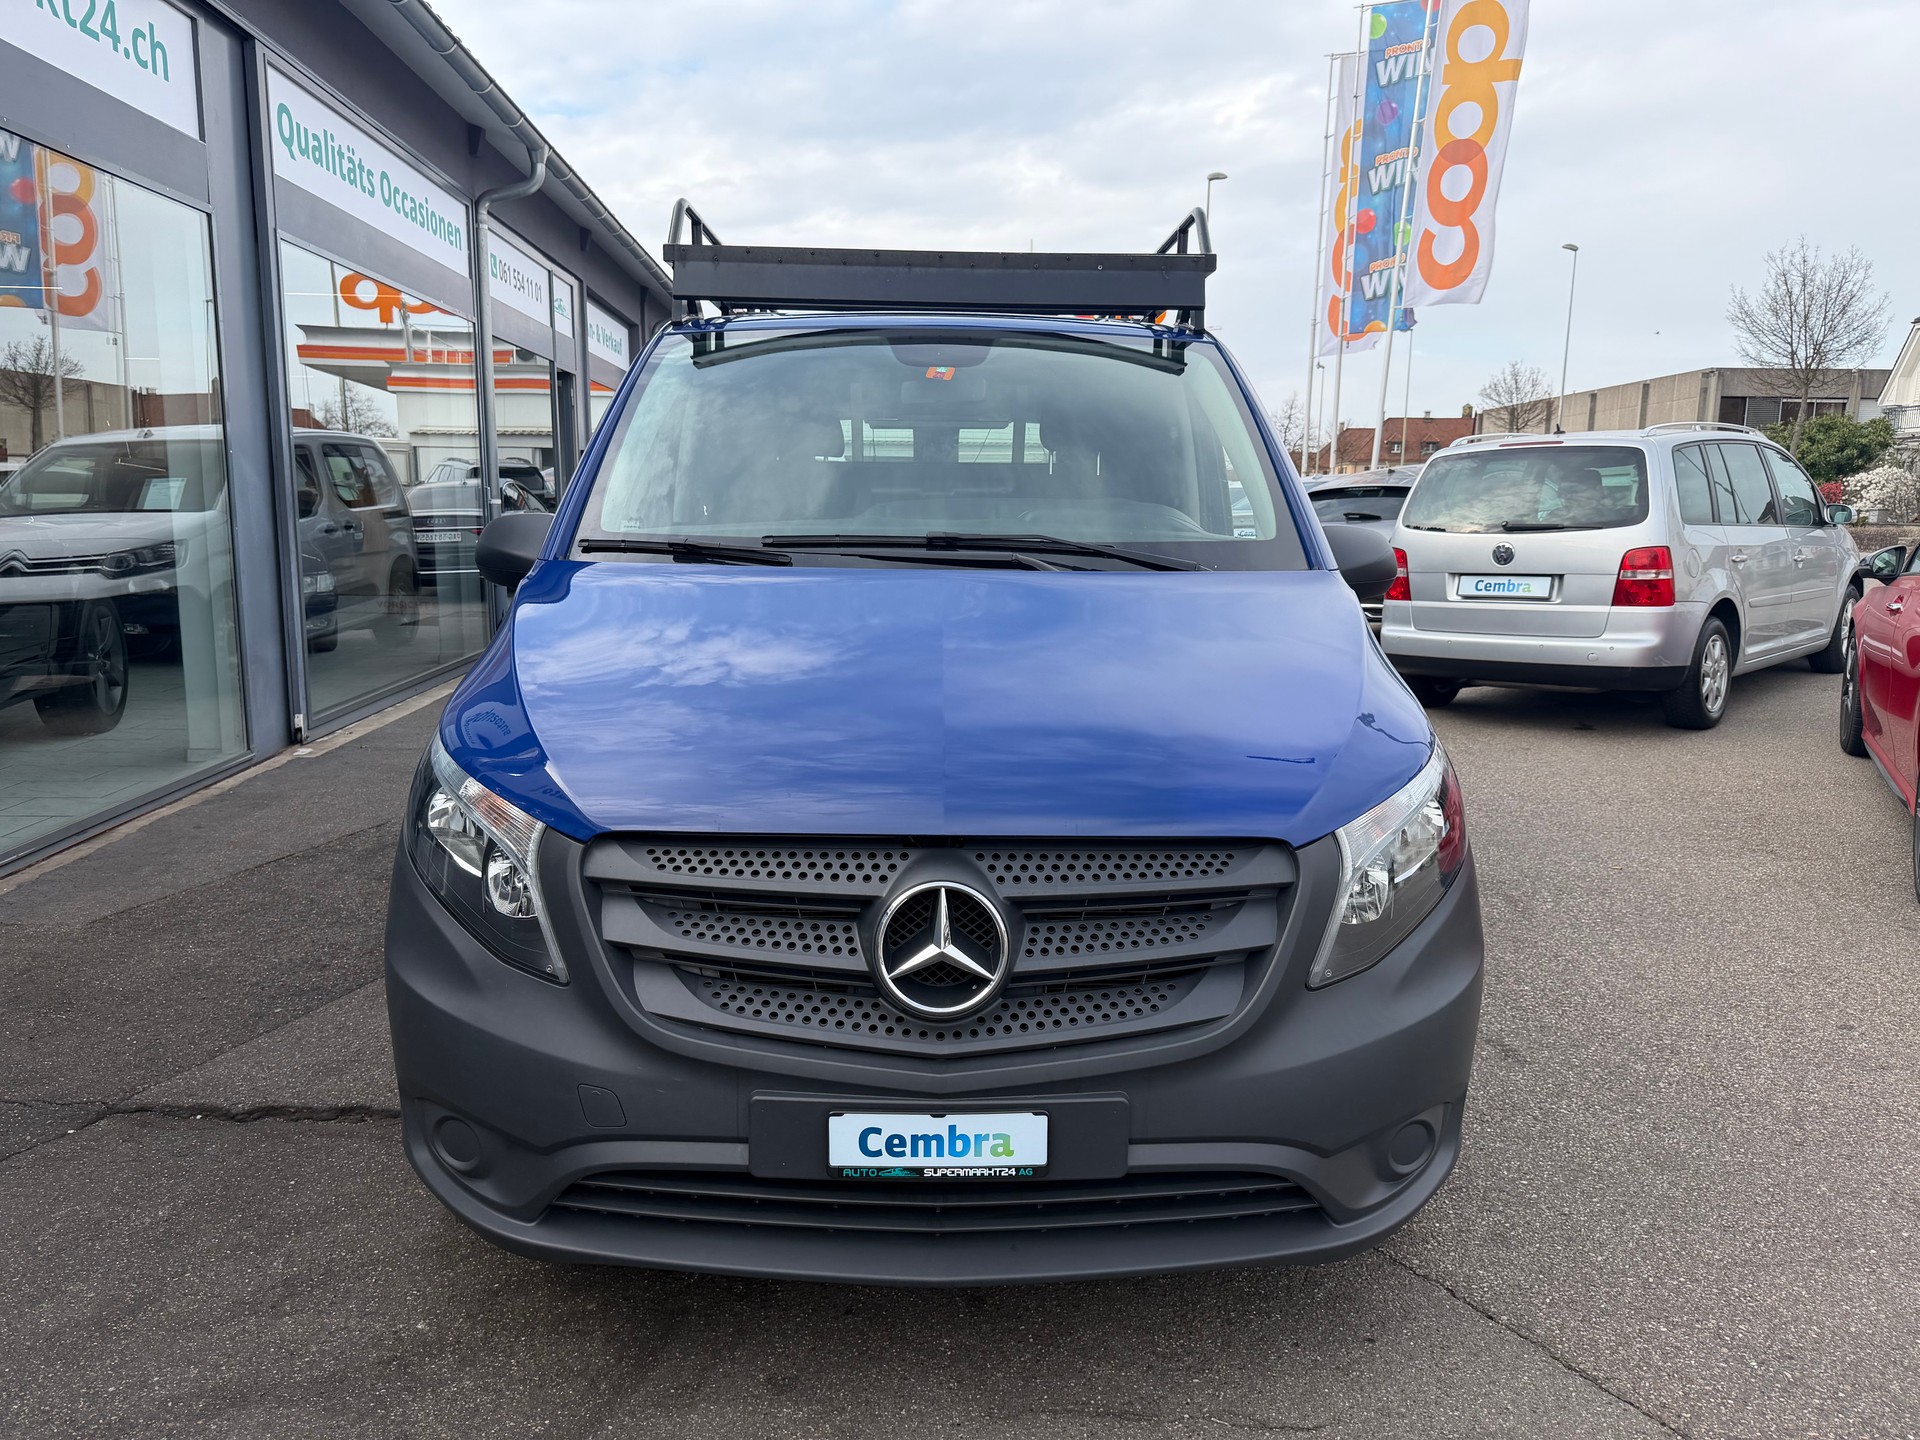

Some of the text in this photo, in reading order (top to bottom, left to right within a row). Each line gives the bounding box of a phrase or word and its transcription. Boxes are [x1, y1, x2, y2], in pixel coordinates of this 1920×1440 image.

[36, 0, 170, 82] t24.ch
[1417, 0, 1523, 290] coop
[276, 102, 462, 251] Qualitäts Occasionen
[498, 259, 542, 304] 061 554 11 01
[596, 325, 601, 343] &
[601, 328, 623, 356] Verkauf
[1474, 579, 1532, 593] Cembra
[858, 1124, 1015, 1158] Cembra
[843, 1168, 1033, 1177] AUTO SUPERMARKT24 AG
